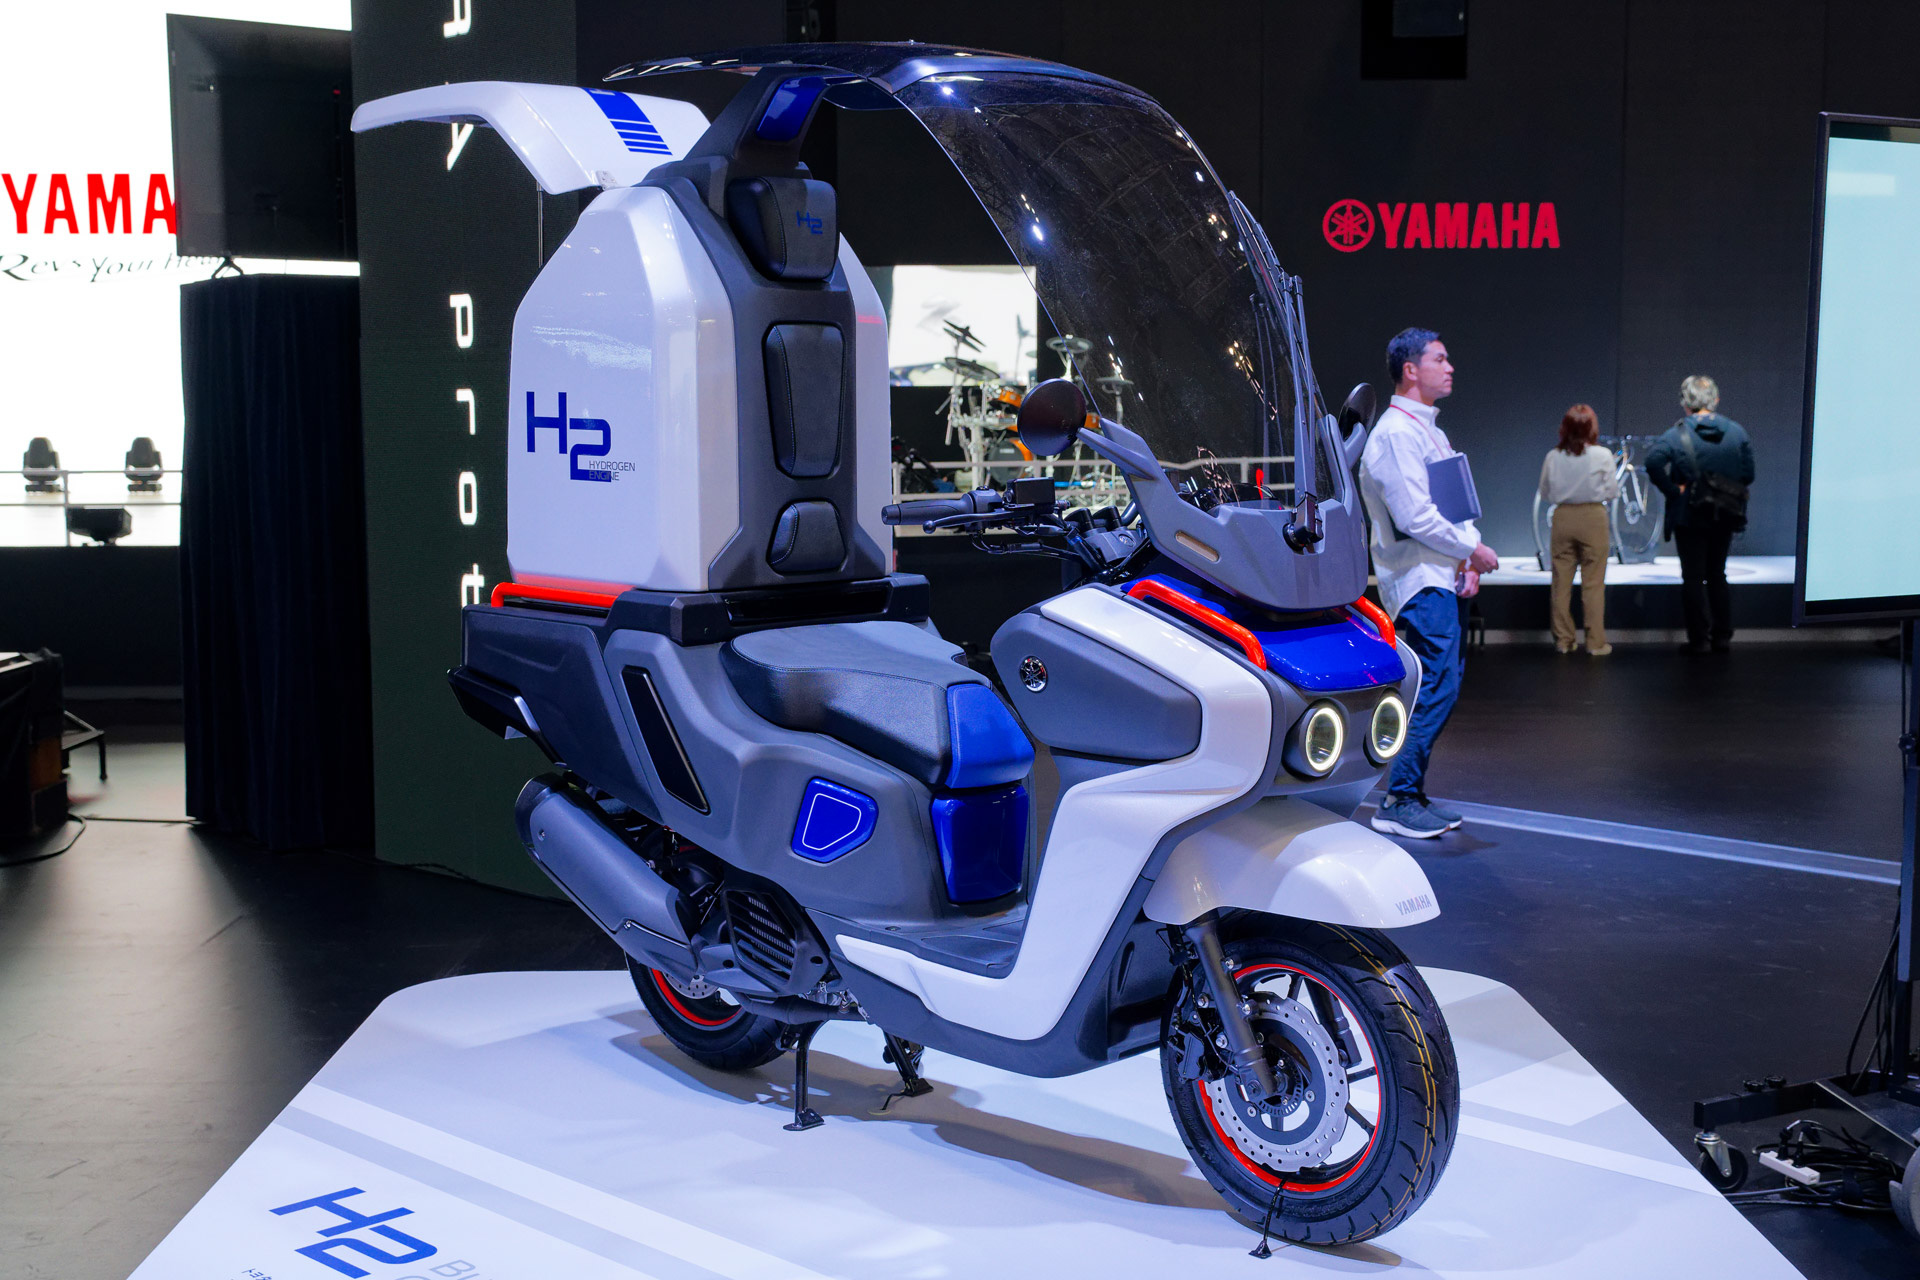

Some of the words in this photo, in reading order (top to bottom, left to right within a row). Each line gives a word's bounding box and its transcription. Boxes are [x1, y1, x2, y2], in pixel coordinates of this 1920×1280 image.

[796, 210, 823, 235] H2
[1377, 202, 1560, 249] YAMAHA
[526, 391, 612, 483] H2
[588, 460, 636, 472] HYDROGEN
[588, 470, 620, 481] ENGINE
[1395, 894, 1432, 916] YAMAHA
[268, 1186, 438, 1279] H2
